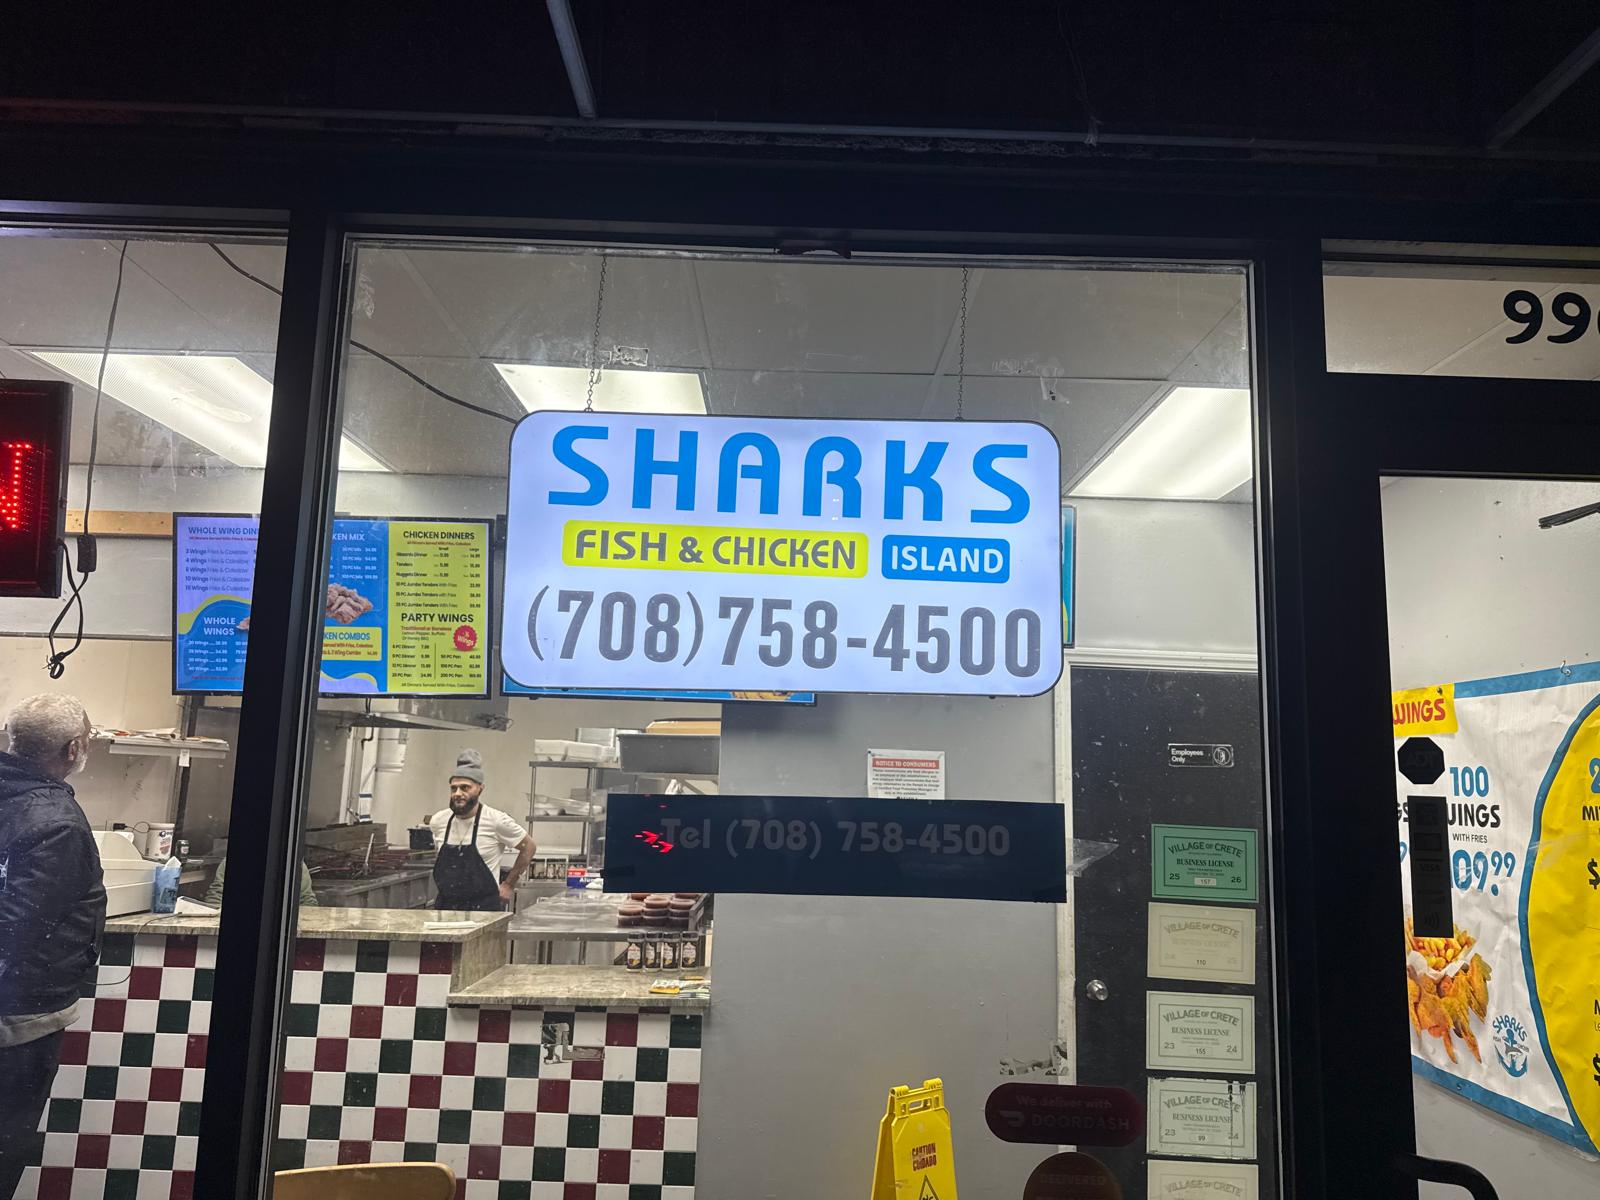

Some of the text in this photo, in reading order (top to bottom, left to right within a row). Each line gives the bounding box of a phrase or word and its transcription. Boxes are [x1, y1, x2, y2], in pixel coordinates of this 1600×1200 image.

[1503, 290, 1600, 344] 99
[547, 425, 1030, 524] SHARKS
[188, 527, 217, 535] WHOLE
[218, 527, 241, 535] WING
[403, 531, 475, 540] CHICKEN DINNERS
[575, 530, 1004, 573] FISH & CHICKEN ISLAND
[203, 617, 236, 625] WHOLE
[401, 613, 474, 623] PARTY WINGS
[203, 628, 235, 636] WINGS
[339, 632, 370, 640] COMBOS
[1171, 748, 1204, 758] Employees
[1171, 756, 1186, 764] Only
[1450, 766, 1489, 798] 100
[661, 818, 1011, 860] Tel (708) 758-4500
[1452, 833, 1488, 844] WITH FRIES
[1168, 842, 1204, 855] VILLAGE
[1214, 843, 1244, 858] CRETE
[1176, 858, 1234, 868] BUSINESS LICENSE
[1451, 849, 1516, 897] 09.99
[1164, 922, 1202, 934] VILLAGE
[1211, 923, 1240, 939] CRETE
[1163, 1009, 1200, 1023] VILLAGE
[1210, 1011, 1240, 1026] CRETE
[1172, 1027, 1230, 1036] BUSINESS LICENSE
[1493, 1015, 1528, 1042] SHARKS
[1164, 1042, 1175, 1050] 23
[1226, 1045, 1238, 1053] 24
[1016, 1095, 1035, 1106] We
[1086, 1099, 1112, 1109] with
[1164, 1096, 1201, 1109] VILLAGE
[1212, 1097, 1241, 1112] CRETE
[1032, 1114, 1129, 1131] DOORDASH
[1173, 1113, 1232, 1123] BUSINESS LICENSE
[912, 1143, 936, 1157] CAUTION
[913, 1155, 937, 1172] CUIDADO
[1165, 1180, 1203, 1193] VILLAGE
[1214, 1182, 1242, 1197] CRETE
